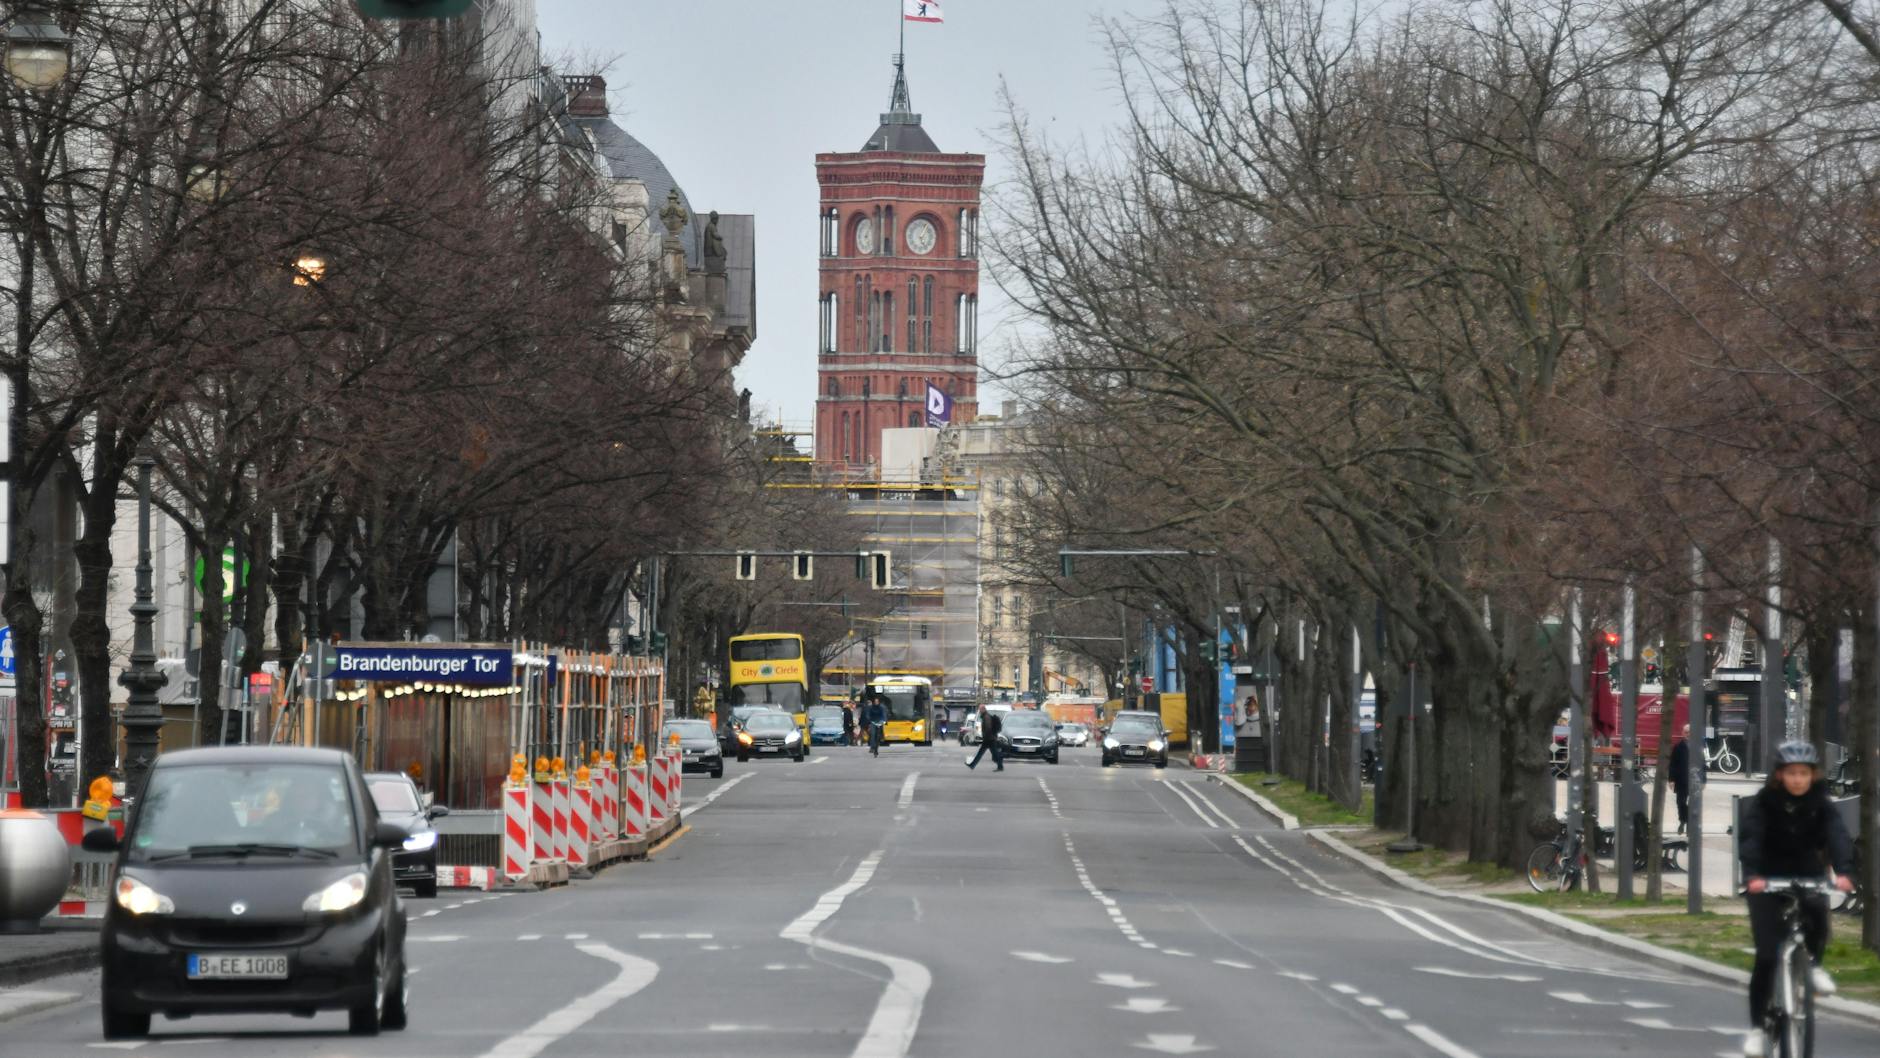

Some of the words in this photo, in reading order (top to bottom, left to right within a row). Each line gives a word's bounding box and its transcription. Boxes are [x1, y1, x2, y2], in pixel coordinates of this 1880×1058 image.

[340, 654, 468, 675] Brandenburger
[472, 655, 500, 672] Tor
[741, 667, 758, 679] City
[775, 665, 799, 674] Circle
